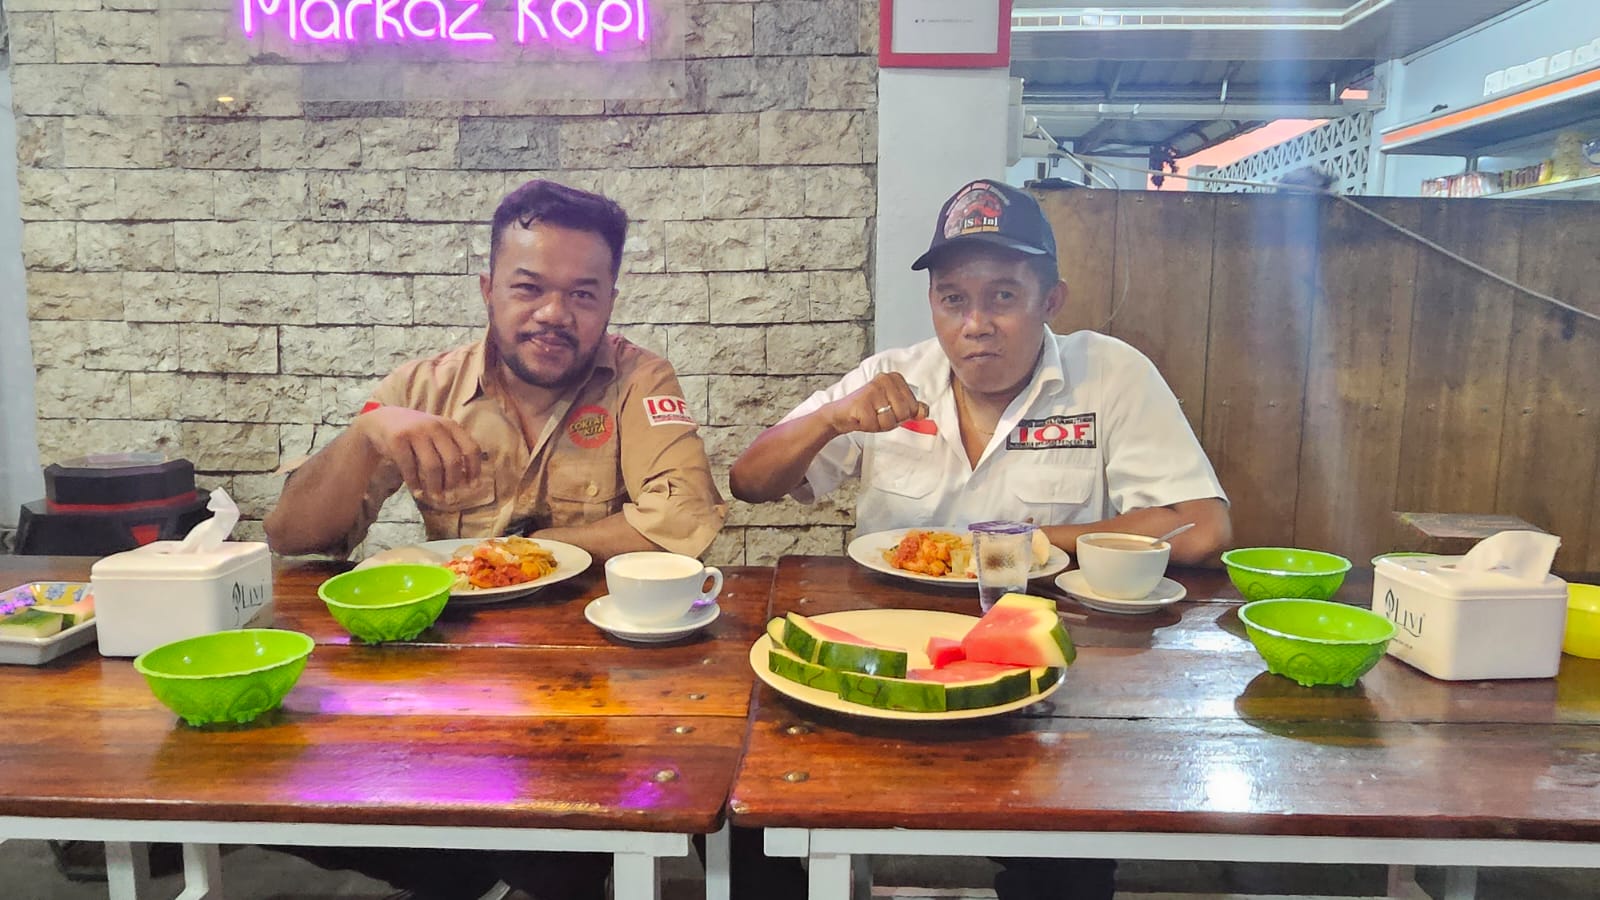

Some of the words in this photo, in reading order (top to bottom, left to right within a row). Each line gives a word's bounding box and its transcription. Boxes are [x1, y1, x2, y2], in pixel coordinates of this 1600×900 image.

[243, 0, 495, 40] Markaz
[517, 0, 645, 52] Kopi
[647, 398, 687, 415] IOF
[1019, 423, 1091, 443] IOF
